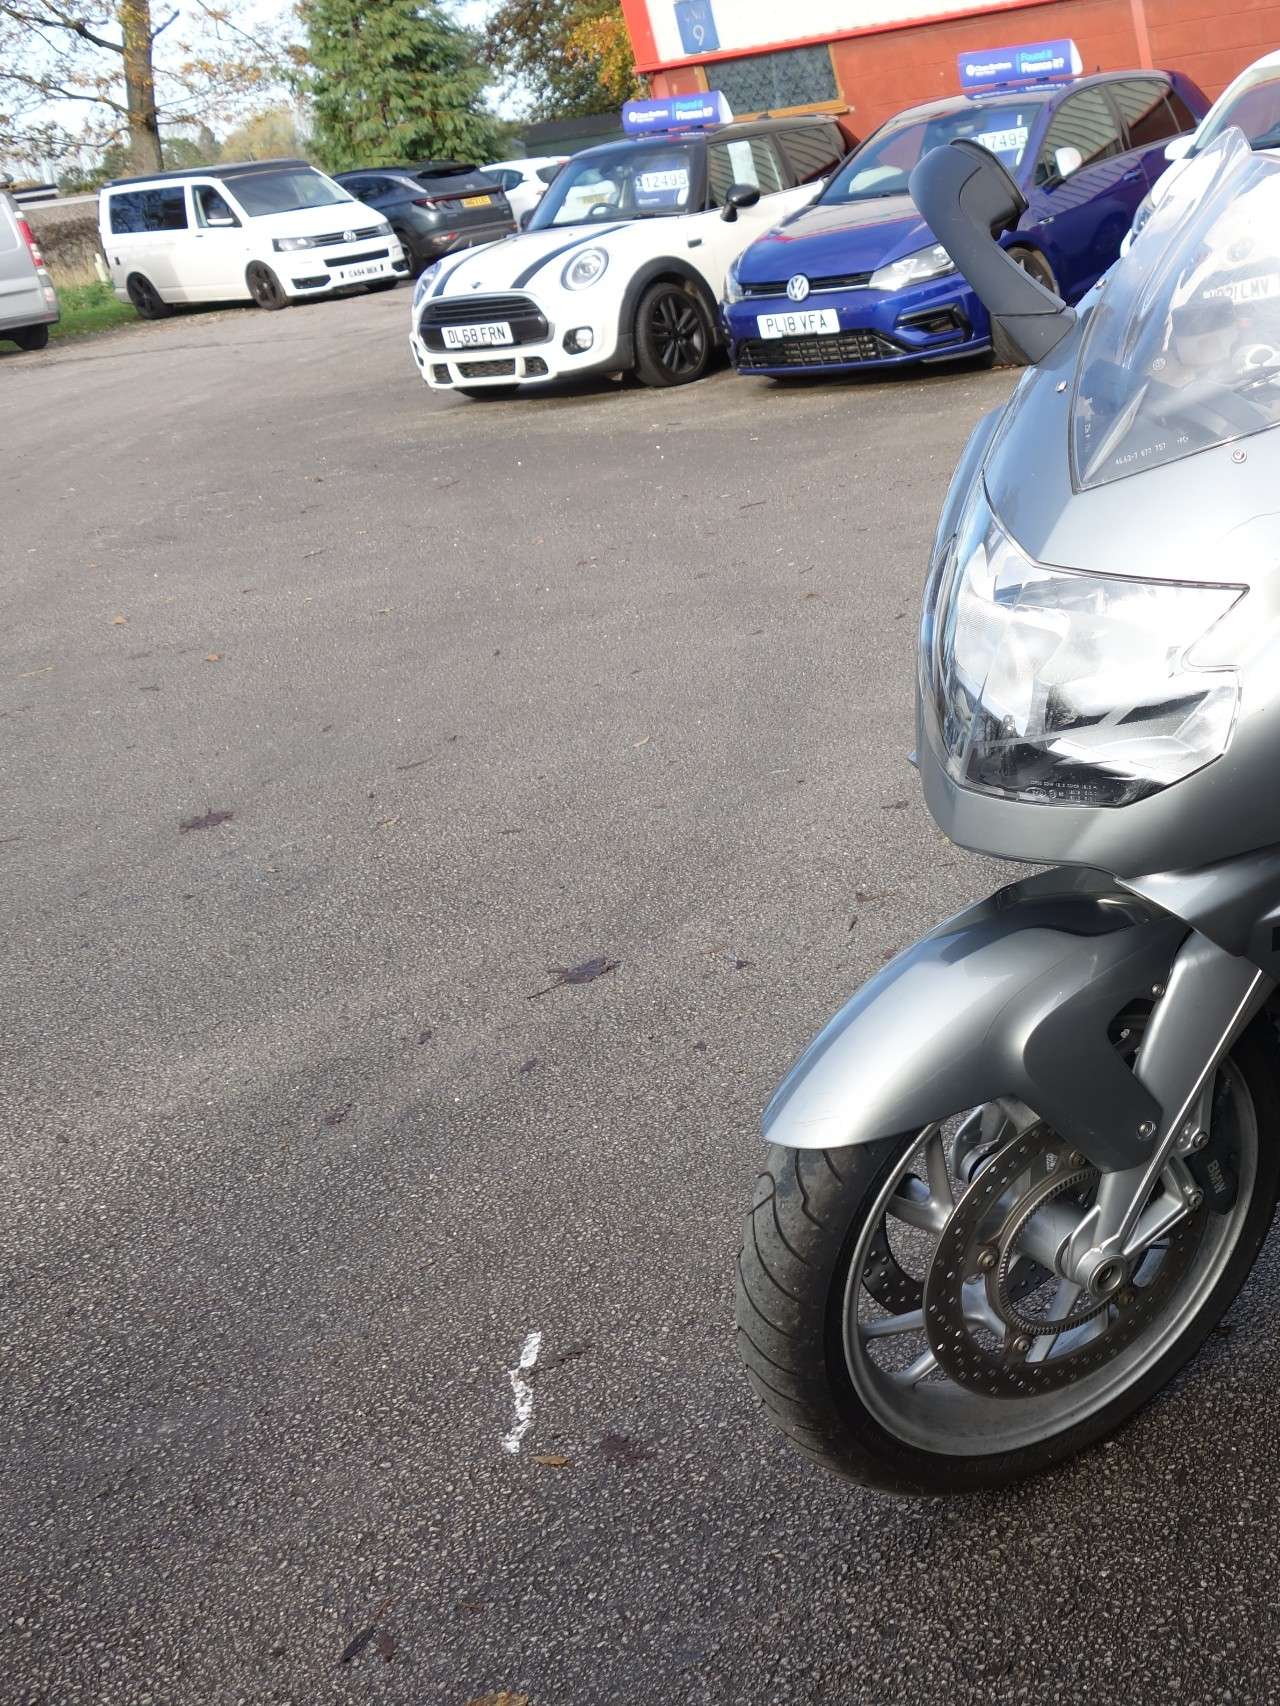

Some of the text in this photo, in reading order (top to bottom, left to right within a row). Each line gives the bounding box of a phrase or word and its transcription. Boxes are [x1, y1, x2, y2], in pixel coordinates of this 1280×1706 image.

[692, 24, 705, 47] 9
[766, 313, 828, 333] PL18 VFA
[448, 325, 507, 344] DL68 FRN
[1208, 1160, 1226, 1194] BMW
